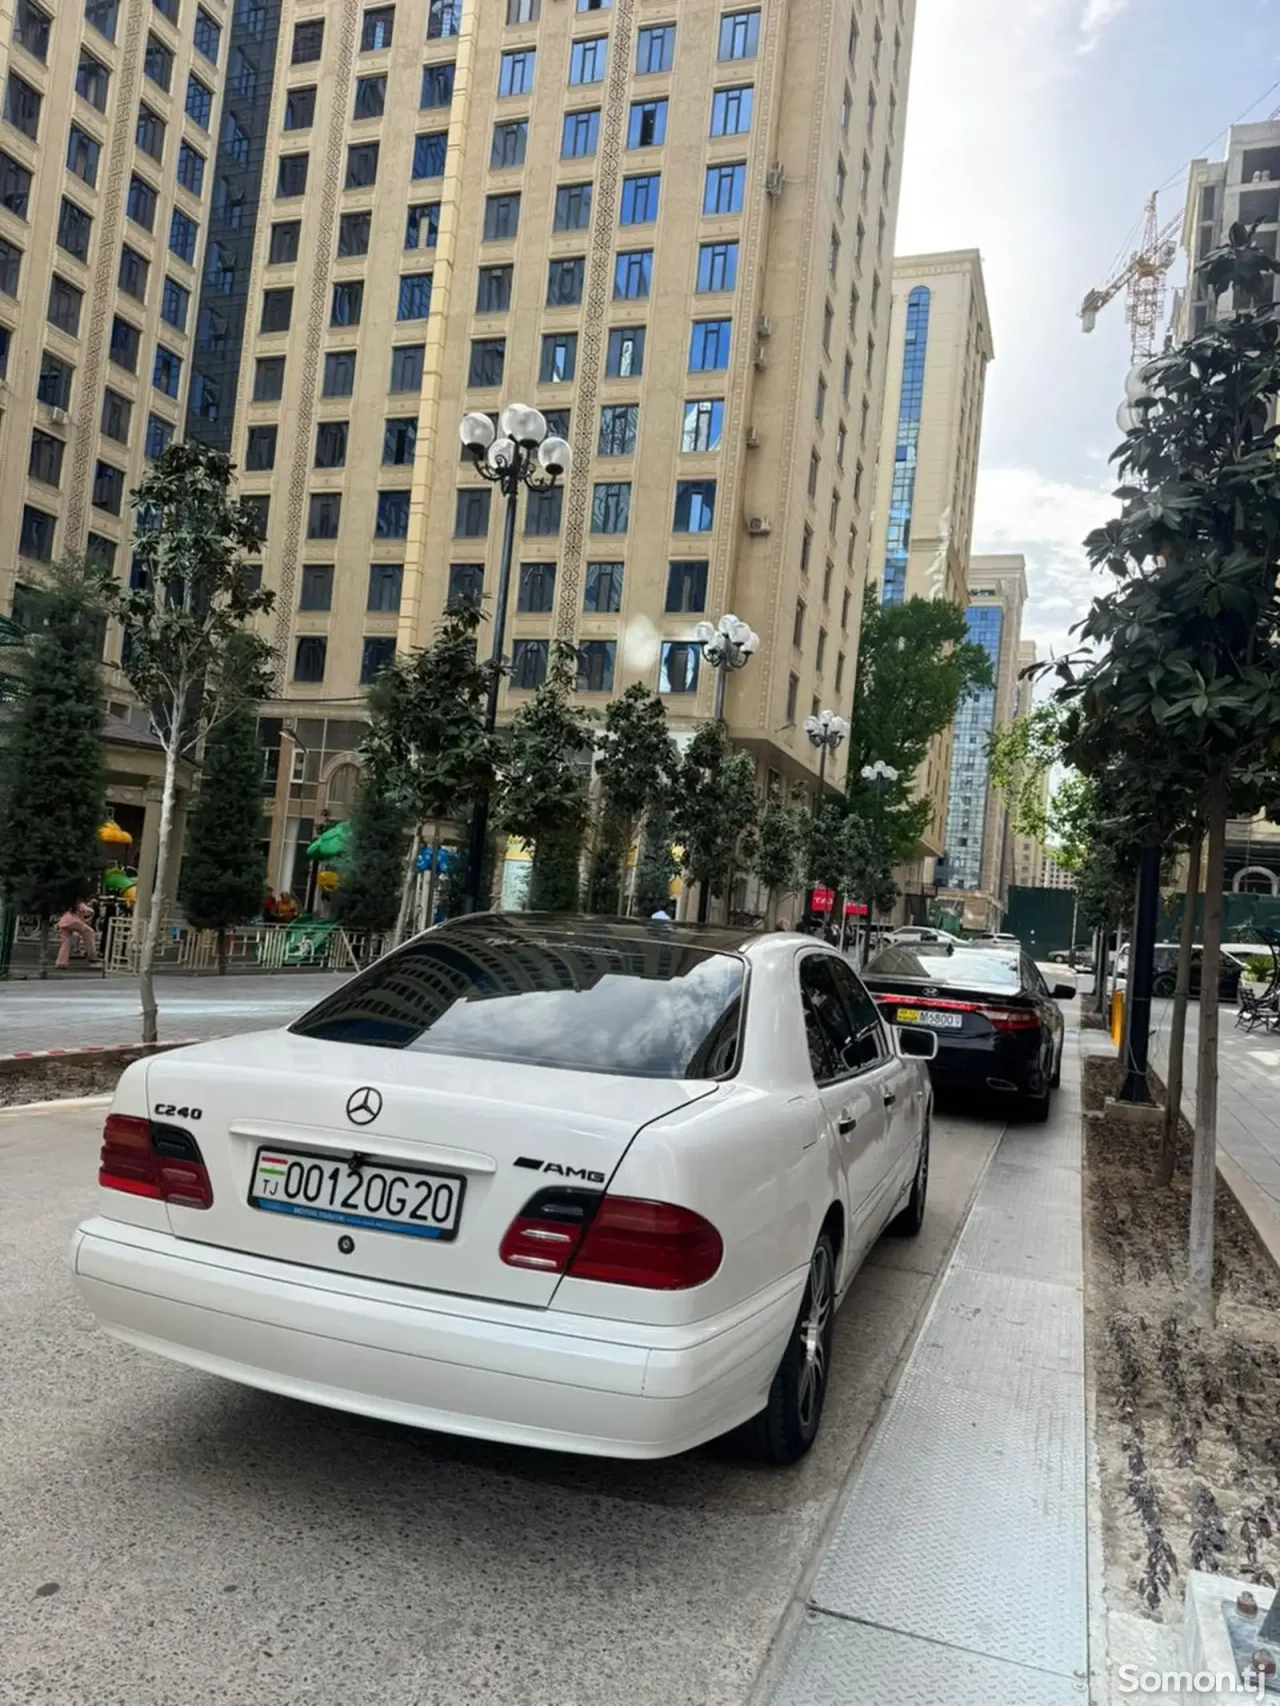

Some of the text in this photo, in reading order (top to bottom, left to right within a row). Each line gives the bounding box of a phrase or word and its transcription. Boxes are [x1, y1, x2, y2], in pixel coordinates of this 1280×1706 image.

[154, 1103, 203, 1120] C240
[543, 1162, 606, 1184] AMG
[263, 1178, 279, 1196] TJ
